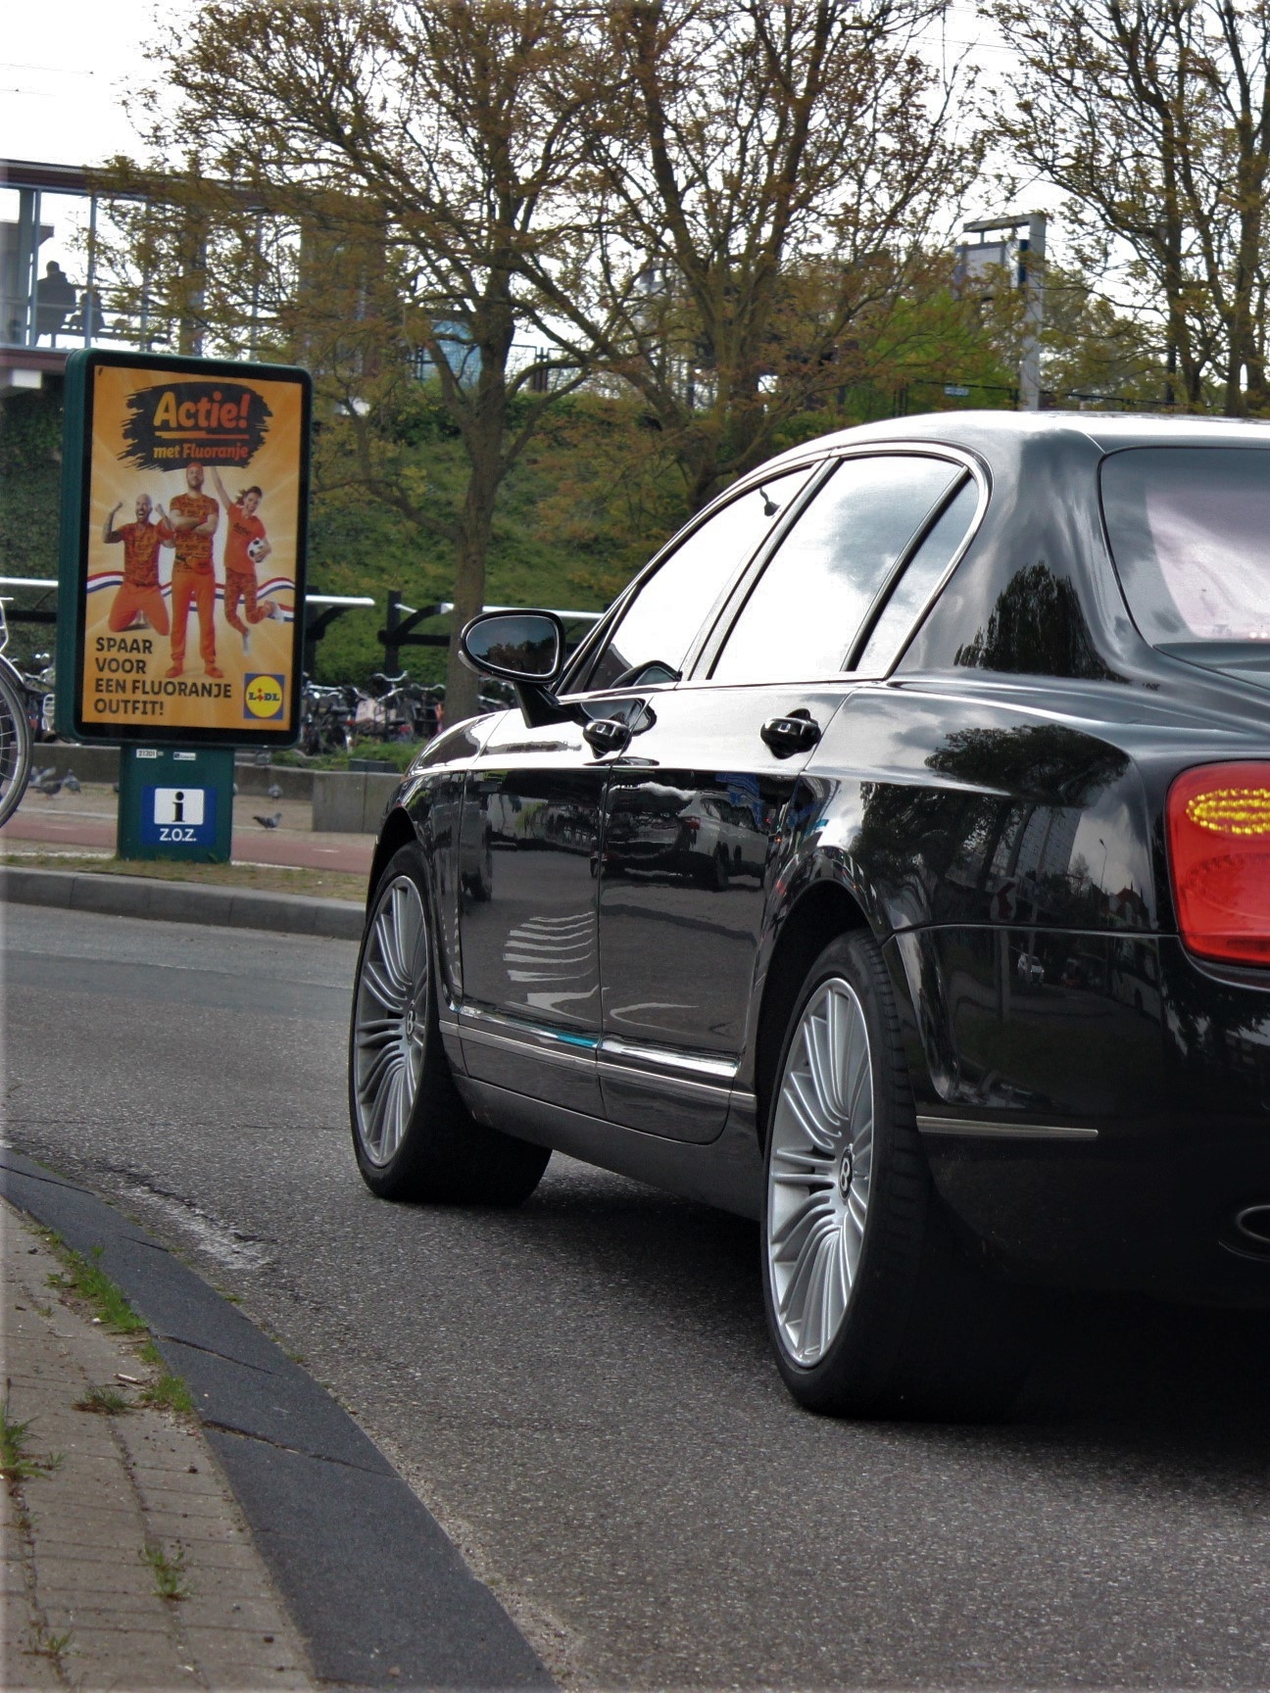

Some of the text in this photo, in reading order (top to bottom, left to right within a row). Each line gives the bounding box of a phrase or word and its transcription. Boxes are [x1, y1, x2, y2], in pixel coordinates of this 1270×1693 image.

[153, 391, 251, 428] Actie!
[153, 442, 249, 461] met Fluoranje
[95, 636, 153, 654] SPAAR
[95, 657, 147, 674] VOOR
[95, 678, 232, 698] EEN FLUORANJE
[94, 698, 164, 716] OUTFIT!
[159, 828, 197, 842] Z.O.Z.
